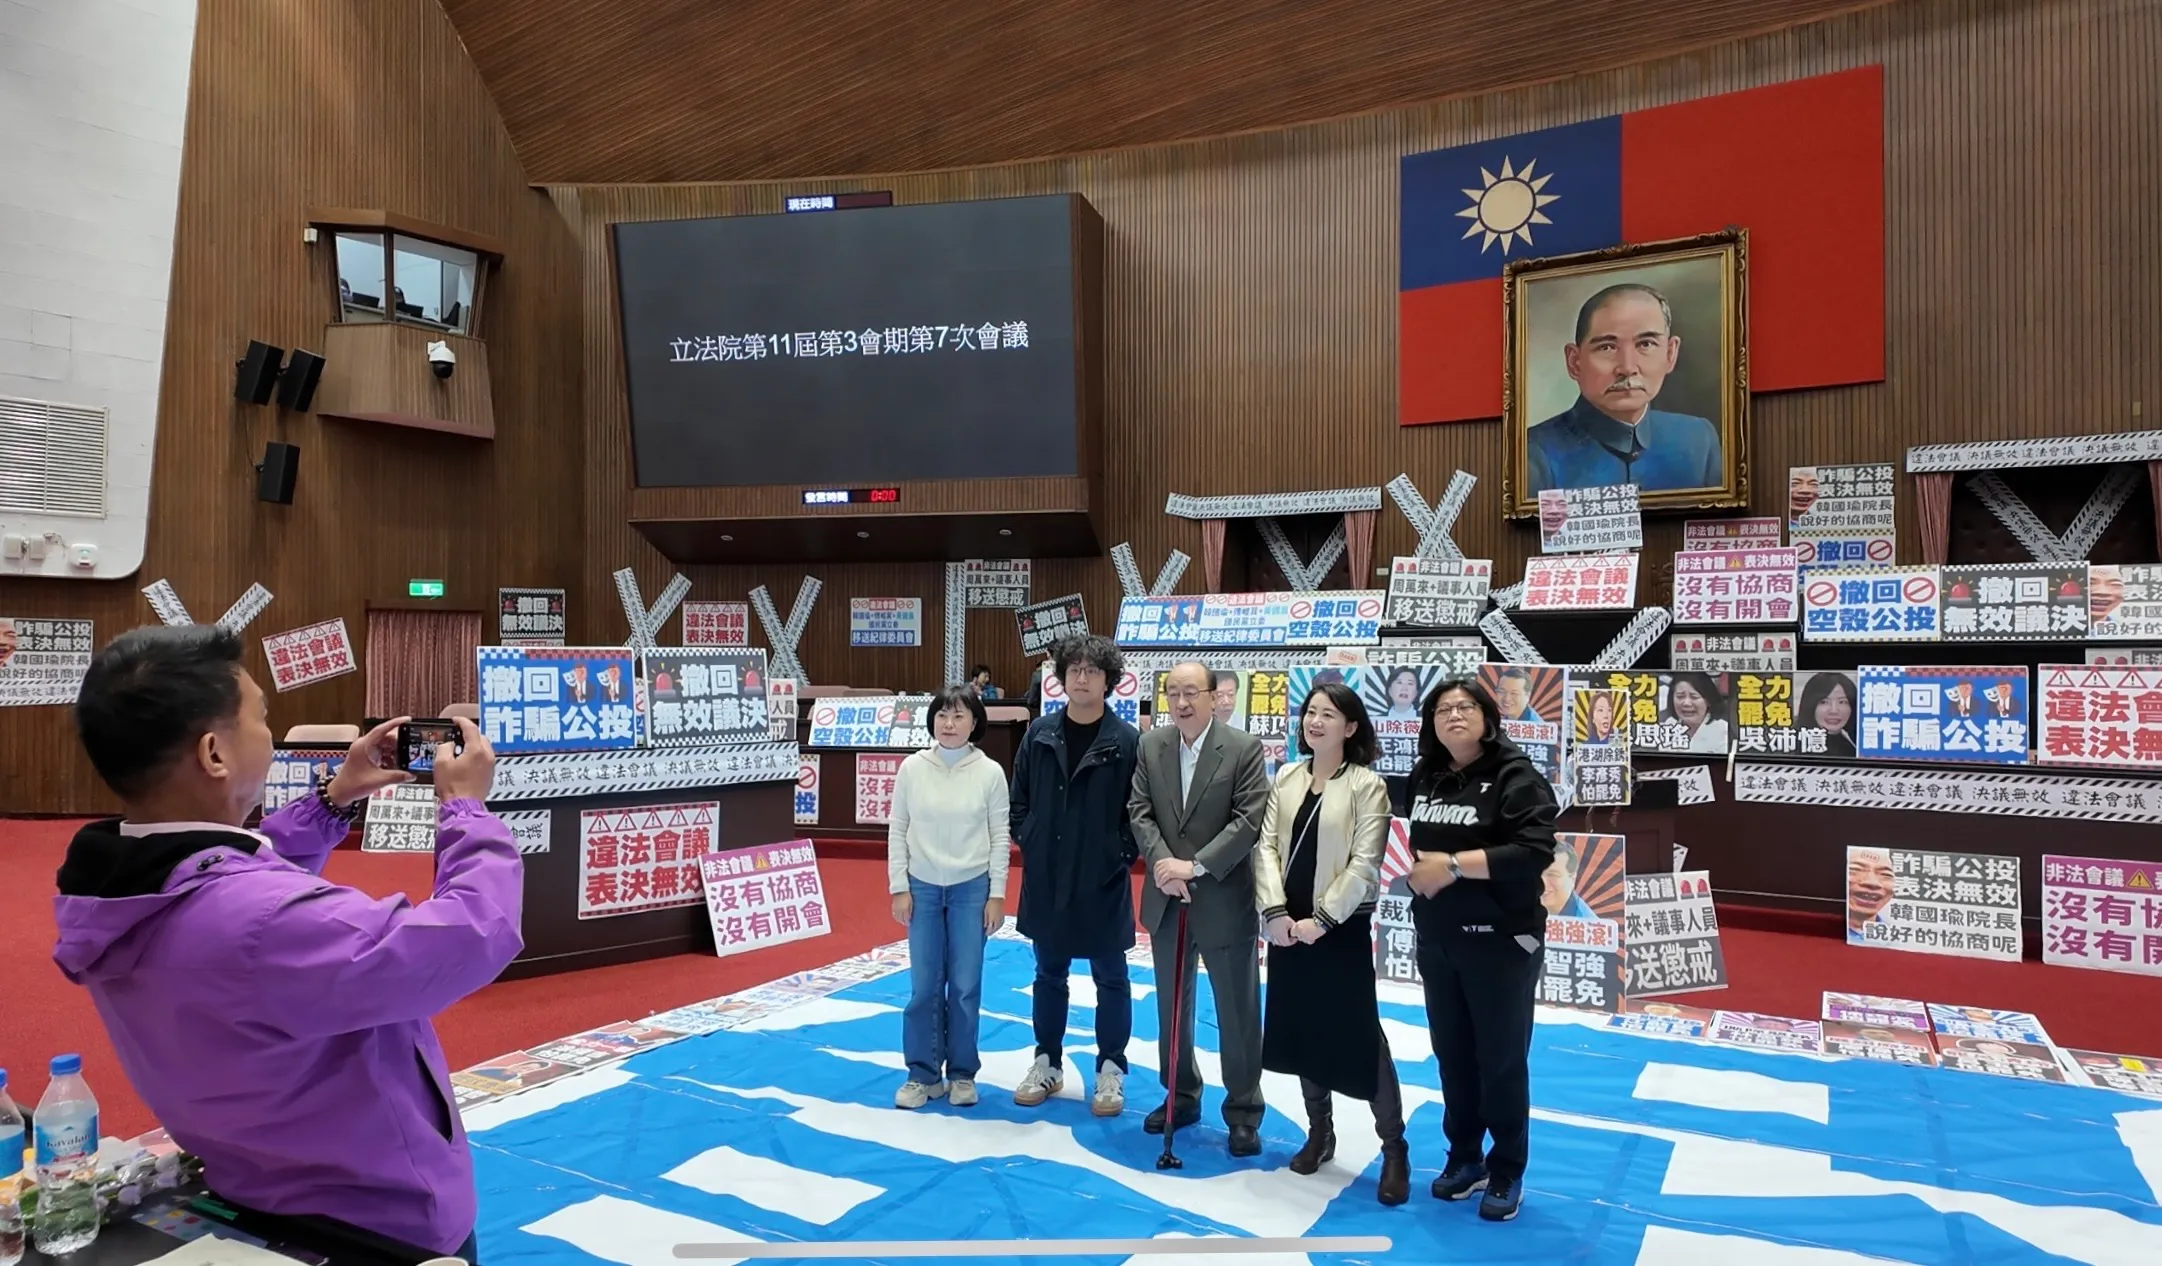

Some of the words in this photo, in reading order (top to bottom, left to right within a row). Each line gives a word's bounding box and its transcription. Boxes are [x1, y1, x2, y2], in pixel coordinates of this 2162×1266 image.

[787, 196, 834, 210] 現在時間
[669, 320, 1030, 363] 立法院第11屆第3會期第7次會議
[1817, 466, 1894, 484] 詐騙公投
[1563, 484, 1639, 503] 詐騙公投
[1818, 483, 1894, 497] 表決無效
[1566, 500, 1639, 517] 表決無效
[1816, 500, 1892, 513] 韓國瑜院長
[1566, 515, 1640, 530] 韓國瑜院長
[1800, 514, 1892, 527] 說好的協商呢
[1551, 530, 1641, 547] 說好的協商呢
[1817, 541, 1866, 560] 撤回
[1420, 560, 1460, 575] 非法會議
[1677, 556, 1726, 571] 非法會議
[1744, 554, 1795, 568] 表決無效
[1393, 577, 1488, 596] 周萬來+議事人員
[1526, 567, 1629, 588] 違法會議
[1677, 574, 1794, 597] 沒有協商
[968, 588, 1025, 606] 移送懲戒
[1524, 587, 1628, 606] 表決無效
[1839, 580, 1902, 605] 撤回
[1978, 576, 2049, 604] 撤回
[517, 596, 549, 614] 撤回
[1121, 604, 1161, 623] 撤回
[1313, 600, 1357, 618] 撤回
[1392, 599, 1478, 627] 移送懲戒
[1677, 598, 1793, 620] 沒有開會
[502, 615, 563, 631] 無效議決
[686, 613, 744, 628] 違法會議
[1034, 606, 1067, 629] 撤回
[1808, 606, 1936, 632] 空殼公投
[1944, 605, 2087, 634] 無效議決
[15, 621, 91, 637] 詐騙公投
[686, 630, 744, 645] 表決無效
[852, 631, 914, 644] 移送紀律委員會
[1117, 622, 1200, 642] 詐騙公投
[1200, 628, 1285, 643] 移送紀律委員會
[1288, 620, 1378, 639] 空殼公投
[16, 636, 91, 652] 表決無效
[271, 632, 344, 667] 違法會議
[1706, 635, 1759, 652] 非法會議
[13, 654, 90, 666] 韓國瑜院長
[277, 651, 350, 684] 表決無效
[1675, 657, 1793, 671] 周萬來+議事人員
[482, 664, 560, 703] 撤回
[680, 663, 739, 698] 撤回
[1737, 675, 1791, 699] 全力
[1862, 681, 1941, 716] 撤回
[484, 705, 633, 743] 詐騙公投
[652, 697, 768, 735] 無效議決
[836, 706, 877, 726] 撤回
[1738, 701, 1793, 726] 罷免
[1739, 726, 1829, 753] 吳沛憶
[1862, 716, 2027, 754] 詐騙公投
[523, 763, 591, 785] 決議無效
[595, 759, 658, 780] 違法會議
[664, 756, 721, 776] 決議無效
[726, 753, 778, 771] 違法會議
[859, 761, 896, 773] 非法會議
[1582, 766, 1621, 783] 李彥秀
[1581, 783, 1622, 801] 怕罷免
[1741, 774, 1807, 793] 違法會議
[1815, 777, 1886, 797] 決議無效
[1889, 780, 1963, 800] 違法會議
[1972, 783, 2051, 806] 決議無效
[2061, 788, 2147, 811] 違法會議
[1410, 795, 1479, 827] Taiwan
[586, 826, 711, 869] 違法會議
[704, 852, 755, 880] 非法會議
[768, 844, 814, 868] 表決無效
[1892, 852, 2018, 884] 詐騙公投
[2046, 862, 2124, 888] 非法會議
[710, 871, 820, 914] 沒有協商
[1893, 875, 2019, 908] 表決無效
[716, 901, 825, 947] 沒有開會
[1890, 903, 2018, 931] 韓國瑜院長
[1865, 923, 2018, 955] 說好的協商呢
[1385, 953, 1413, 979] 怕
[1543, 950, 1606, 979] 智強
